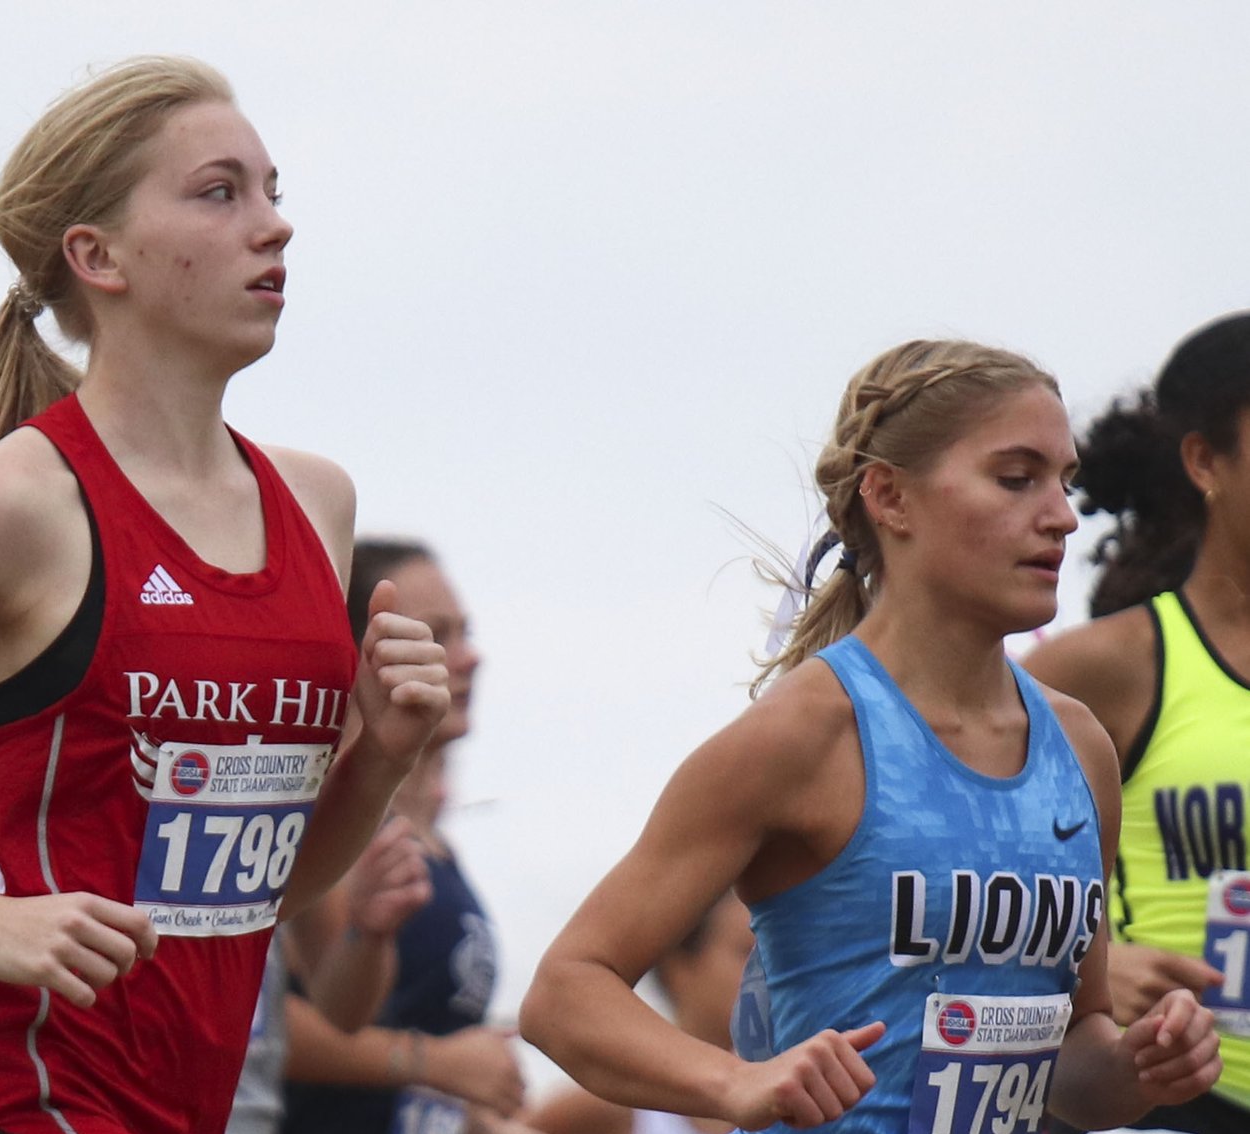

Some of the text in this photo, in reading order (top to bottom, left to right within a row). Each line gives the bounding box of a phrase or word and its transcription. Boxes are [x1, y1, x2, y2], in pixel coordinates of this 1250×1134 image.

[140, 590, 194, 604] adidas
[123, 671, 350, 731] PARK HIL
[215, 755, 307, 775] CROSS COUNTRY
[210, 776, 305, 792] STATE CHAMPIONSHIP
[157, 811, 306, 893] 1798
[890, 869, 1105, 974] LIONS
[981, 1005, 1058, 1026] CROSS COUNTRY
[976, 1027, 1000, 1042] STATE
